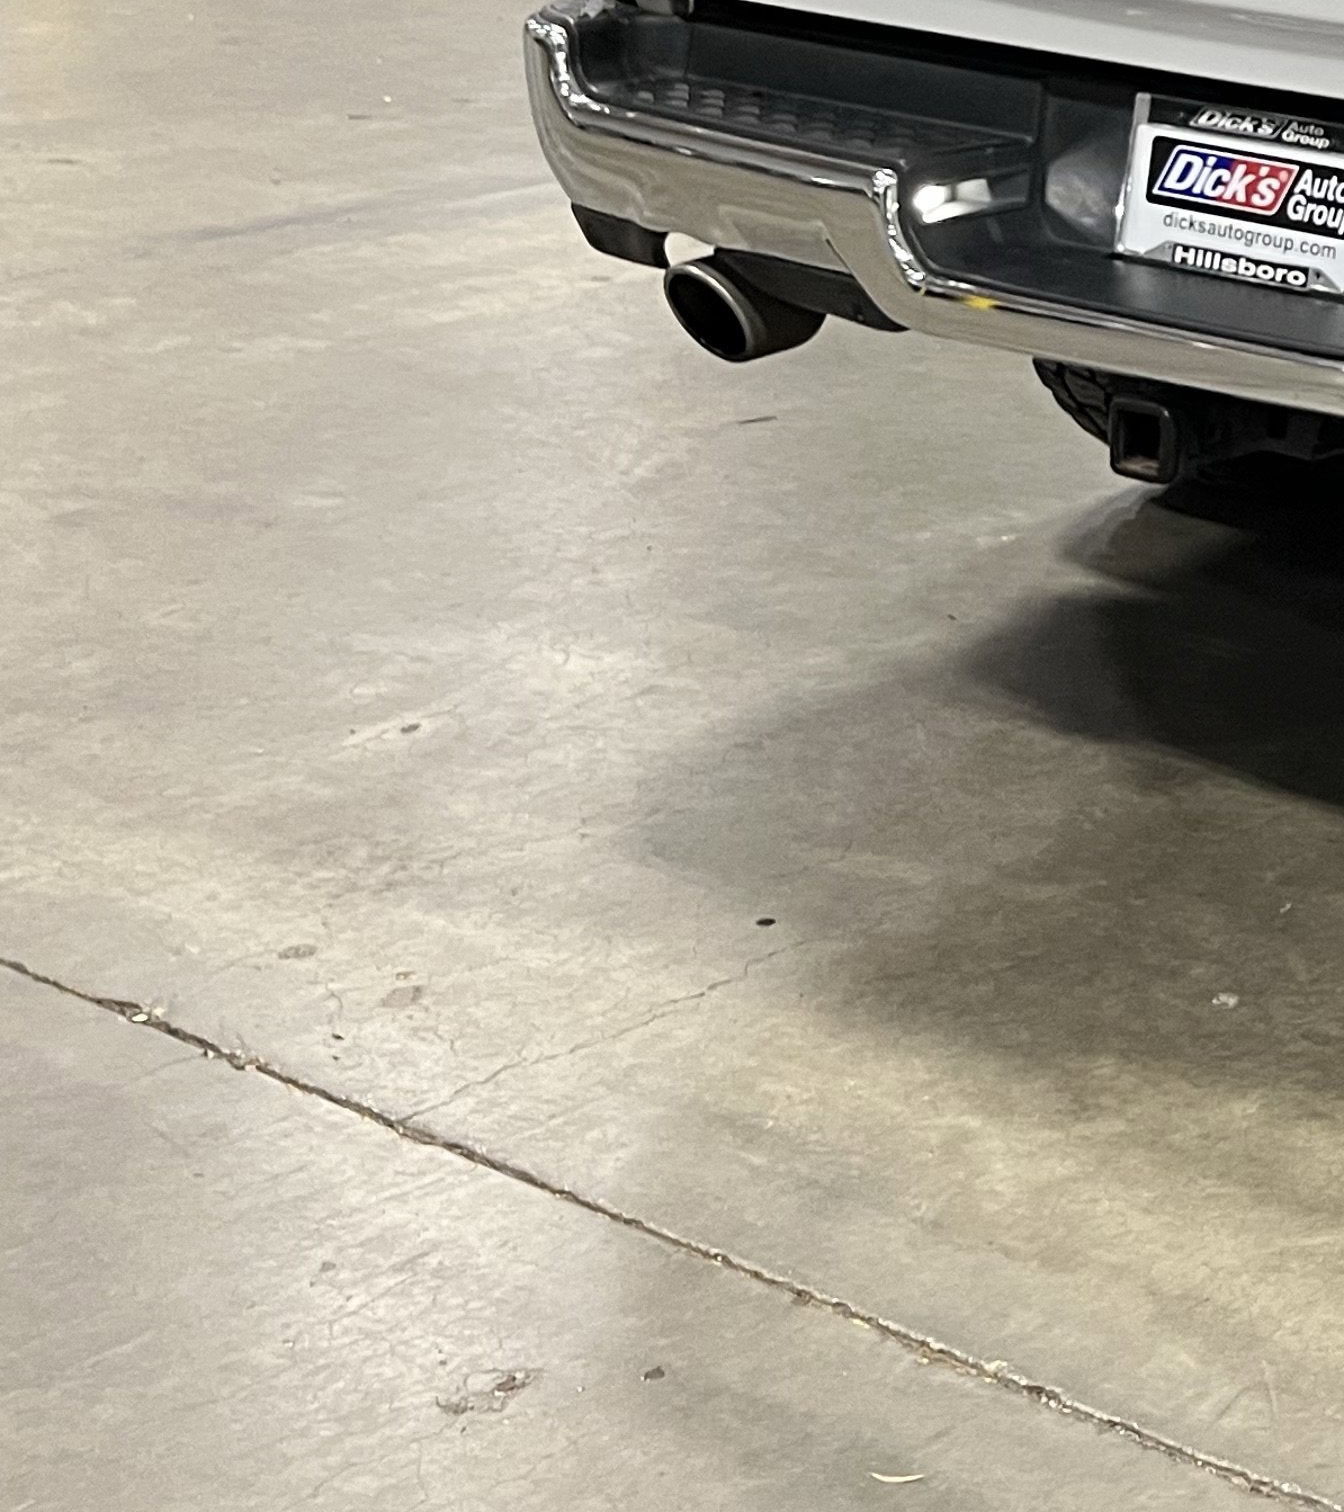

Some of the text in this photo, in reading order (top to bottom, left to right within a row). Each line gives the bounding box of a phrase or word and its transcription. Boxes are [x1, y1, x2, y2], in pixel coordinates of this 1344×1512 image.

[1196, 109, 1277, 136] Dick's
[1289, 120, 1325, 137] Auto
[1281, 129, 1331, 150] Group
[1163, 152, 1285, 208] Dick's
[1162, 211, 1338, 260] dicksautogroup.com
[1172, 245, 1307, 285] Hillsboro
